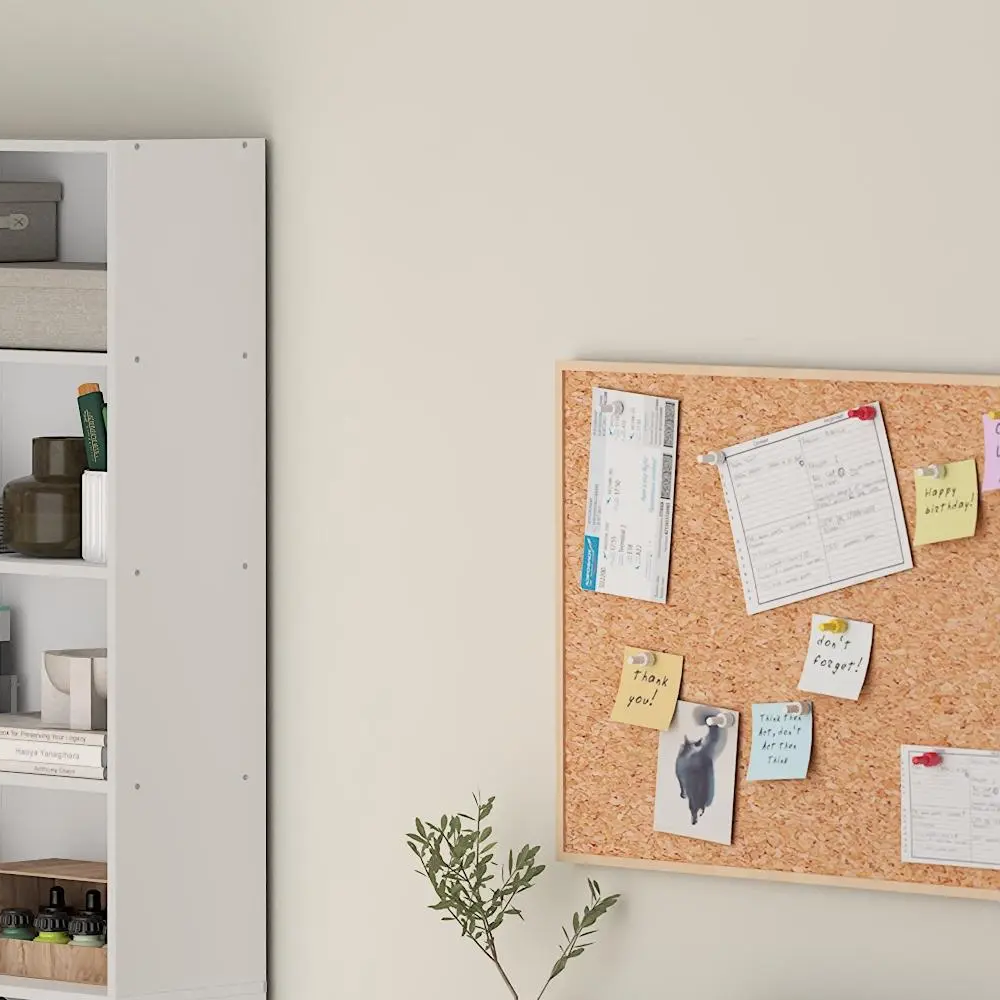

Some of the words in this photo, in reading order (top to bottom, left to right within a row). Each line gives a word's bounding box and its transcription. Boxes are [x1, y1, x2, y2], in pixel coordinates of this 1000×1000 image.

[924, 487, 957, 499] Happy
[924, 491, 975, 515] birthday!
[816, 634, 852, 650] don't
[813, 654, 863, 675] forget!
[626, 689, 658, 708] you!
